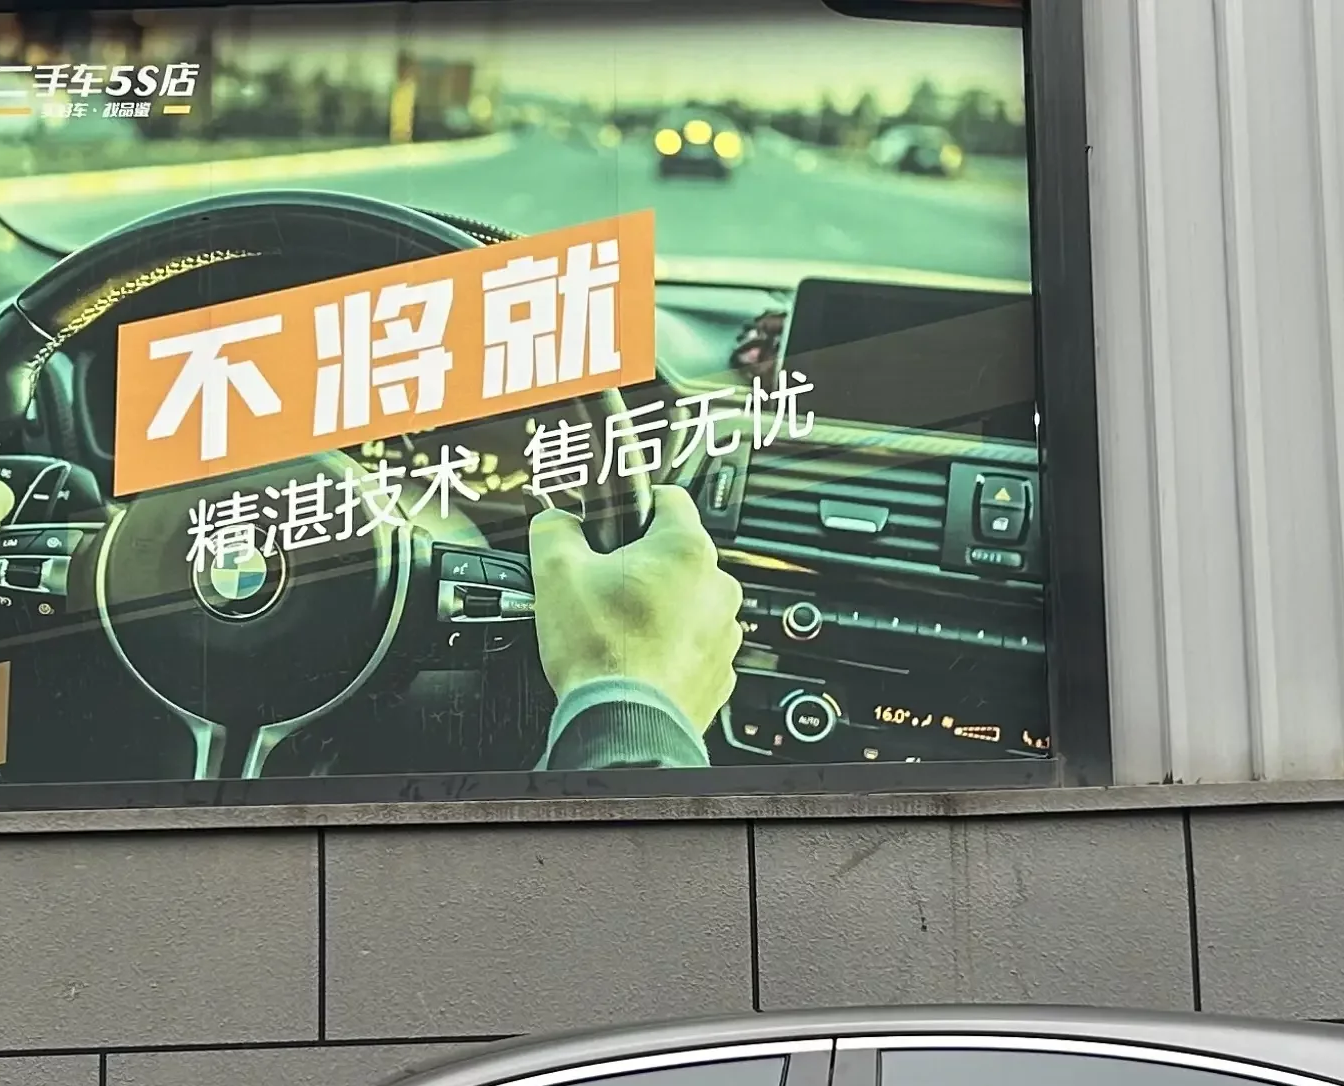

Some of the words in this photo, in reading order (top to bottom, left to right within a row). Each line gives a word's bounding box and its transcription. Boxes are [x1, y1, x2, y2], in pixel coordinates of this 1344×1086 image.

[146, 238, 621, 462] 不将就
[185, 442, 482, 575] 精湛技术
[524, 368, 815, 498] 售后无忧
